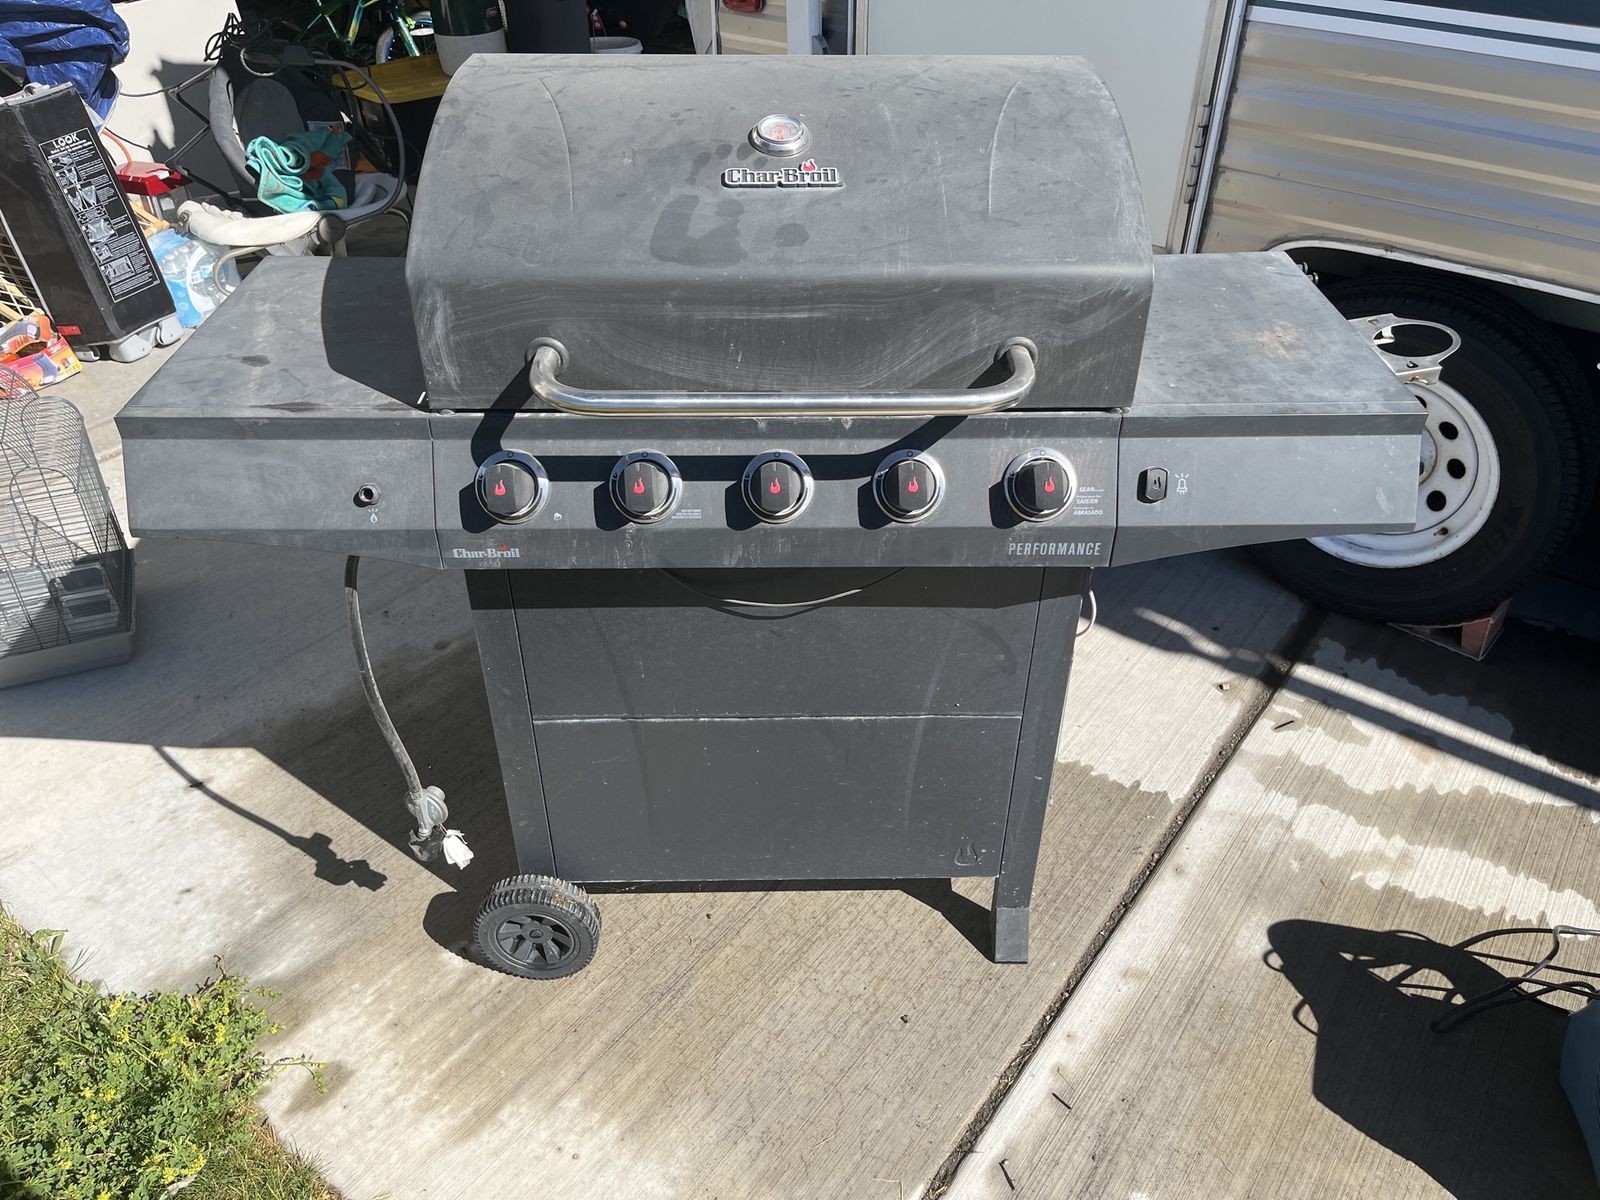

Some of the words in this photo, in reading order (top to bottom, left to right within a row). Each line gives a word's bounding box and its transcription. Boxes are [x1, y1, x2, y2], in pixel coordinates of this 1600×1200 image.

[52, 132, 80, 149] LOOK
[724, 167, 838, 184] Char-Broil
[453, 548, 520, 558] Char-Broil
[1008, 542, 1102, 556] PERFORMANCE
